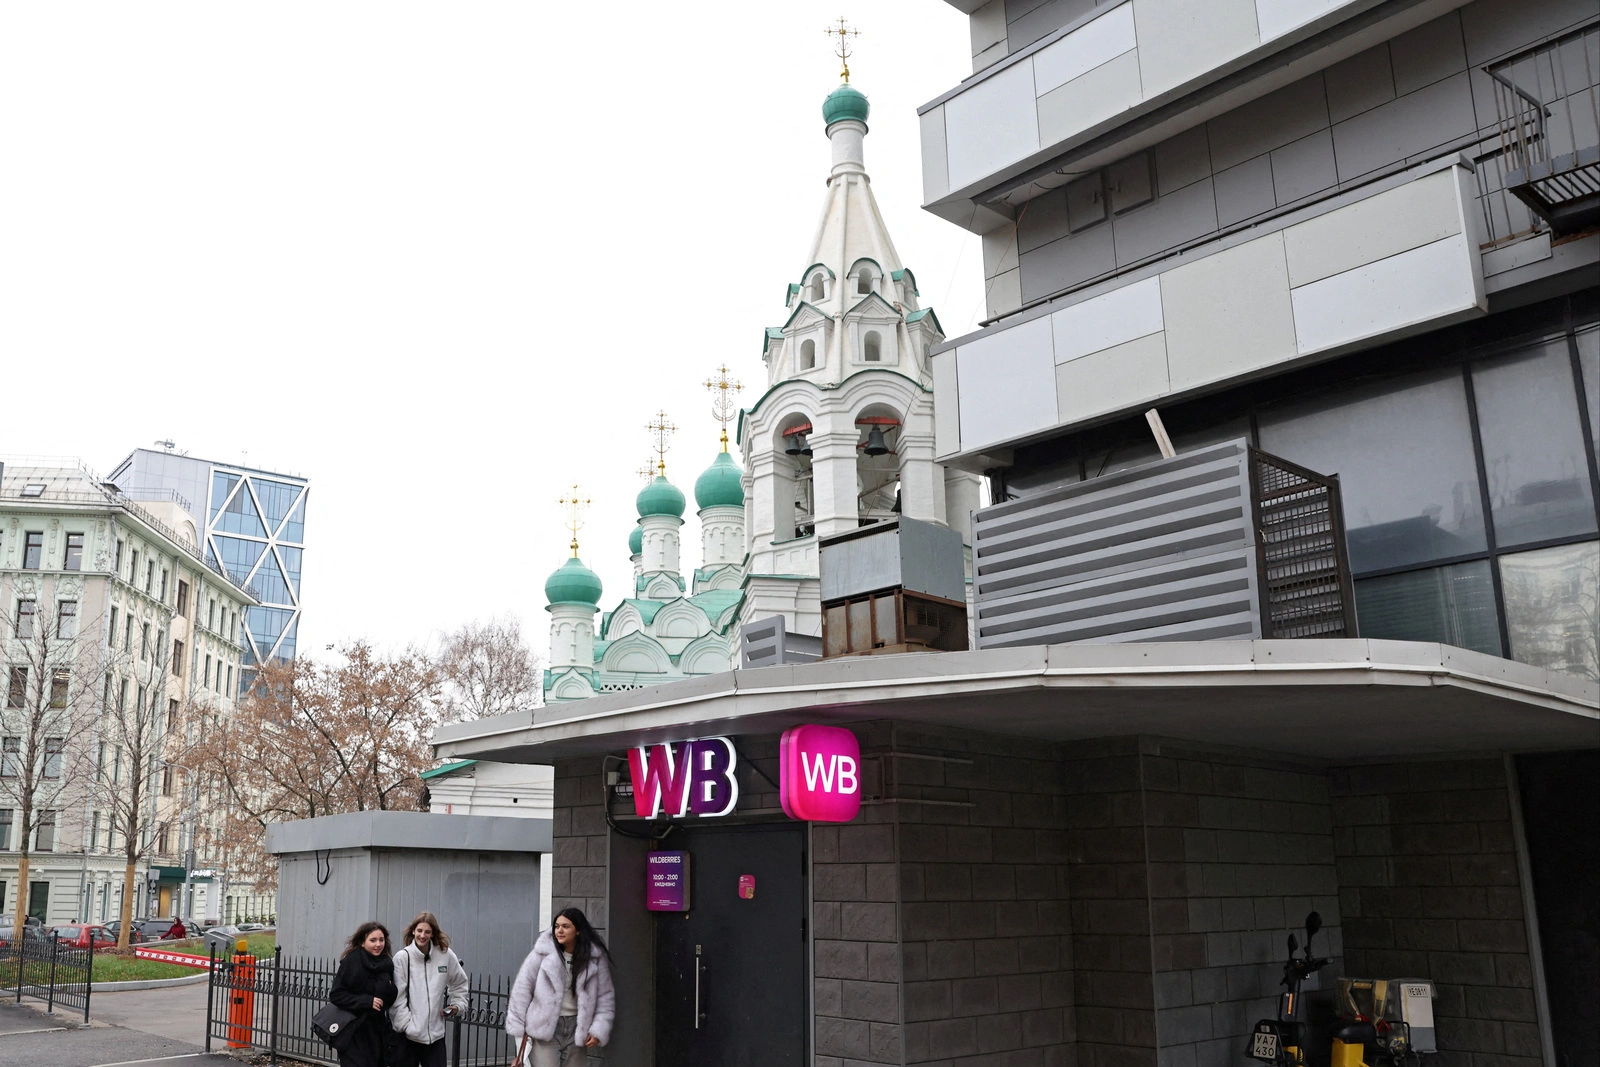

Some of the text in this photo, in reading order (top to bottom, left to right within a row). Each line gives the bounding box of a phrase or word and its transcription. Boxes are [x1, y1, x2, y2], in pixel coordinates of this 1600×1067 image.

[627, 737, 738, 819] WB
[801, 751, 858, 795] WB
[649, 856, 681, 864] WILDBERRIES
[1255, 1046, 1274, 1057] 430
